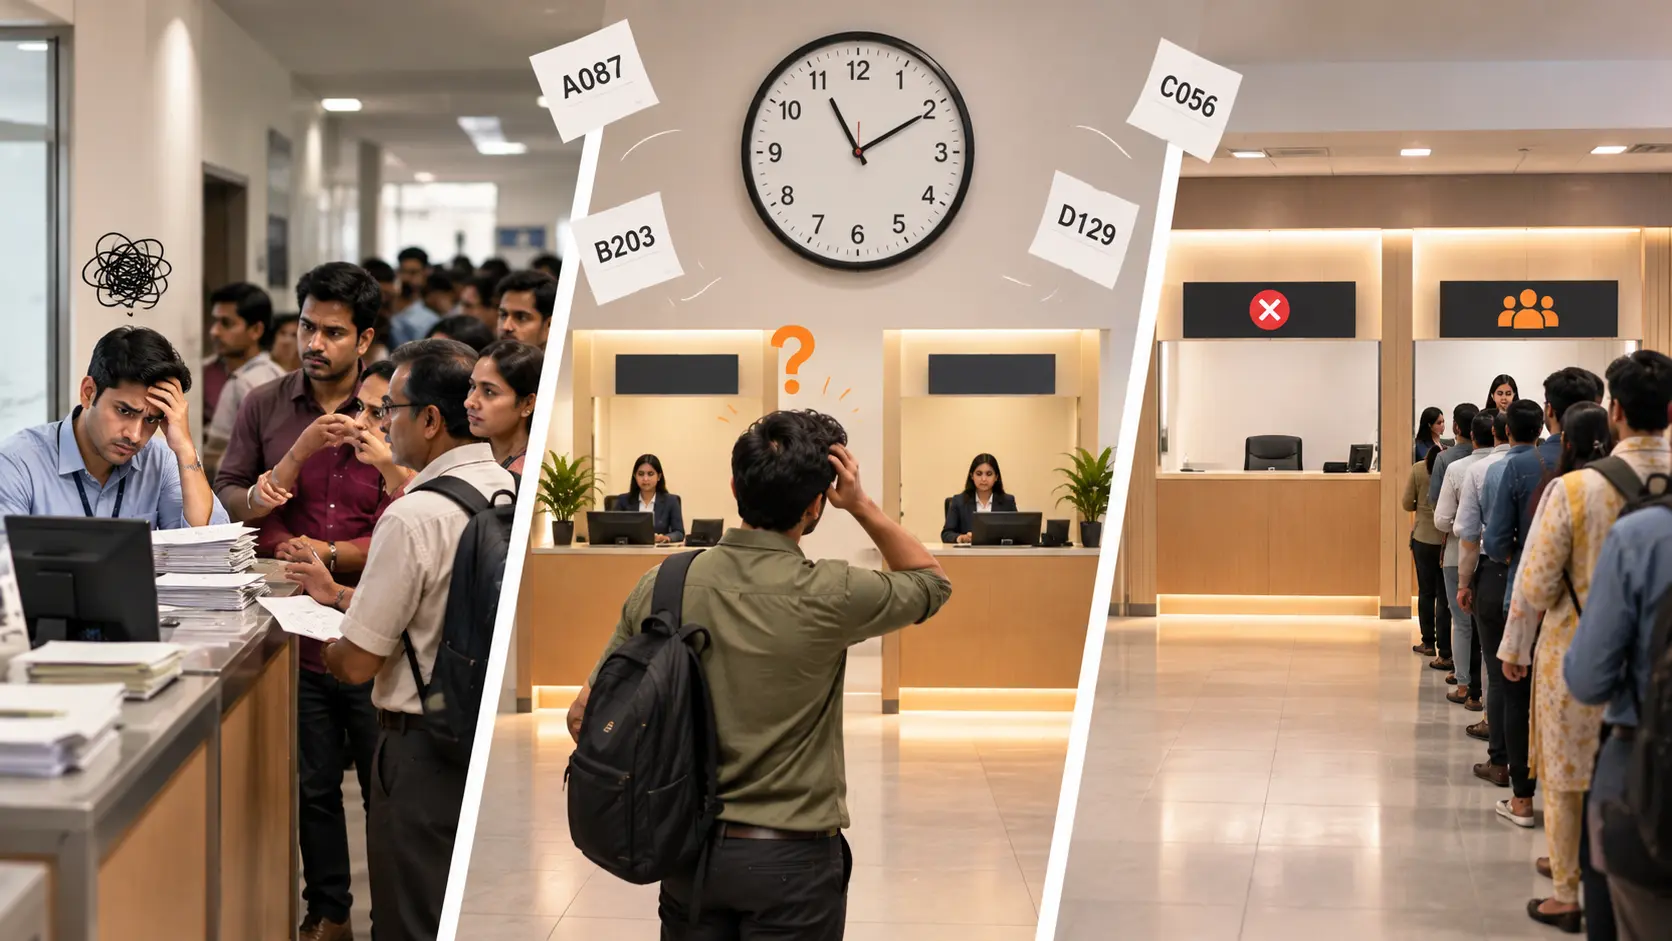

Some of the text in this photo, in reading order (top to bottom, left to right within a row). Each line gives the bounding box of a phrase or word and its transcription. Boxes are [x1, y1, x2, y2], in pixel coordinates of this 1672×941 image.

[562, 54, 623, 100] A087
[808, 69, 827, 91] 11
[846, 59, 870, 81] 12
[895, 69, 904, 90] 1
[1160, 74, 1218, 118] C056
[778, 99, 802, 121] 10
[922, 99, 937, 120] 2
[768, 142, 783, 163] 9
[934, 141, 948, 163] 3
[780, 185, 795, 206] 8
[921, 185, 936, 204] 4
[811, 213, 825, 235] 7
[850, 224, 865, 245] 6
[892, 213, 906, 235] 5
[1057, 203, 1117, 246] D129
[594, 225, 656, 264] B203
